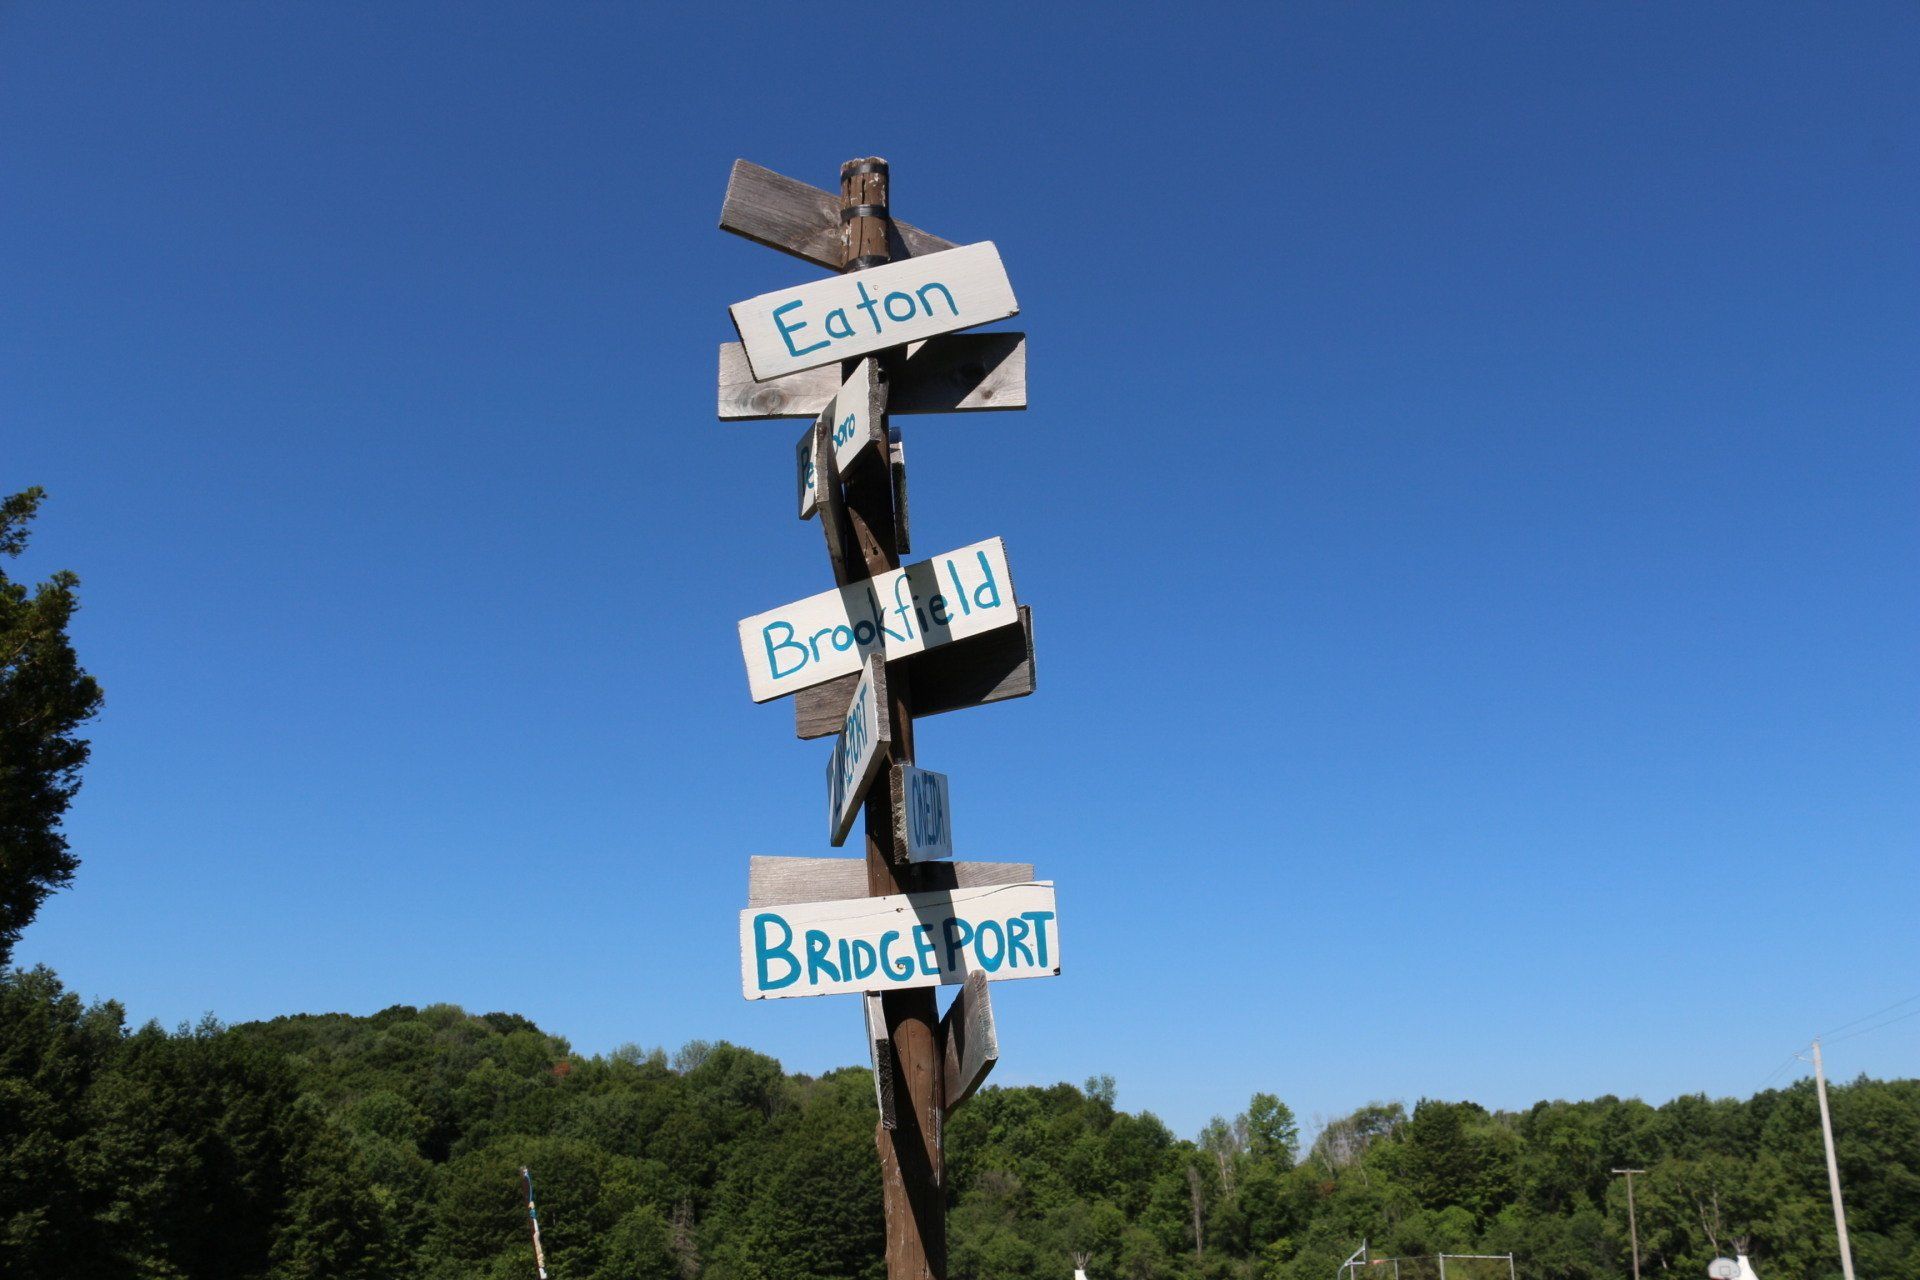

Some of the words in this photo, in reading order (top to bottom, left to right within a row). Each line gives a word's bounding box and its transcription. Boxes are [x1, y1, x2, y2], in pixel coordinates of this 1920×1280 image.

[773, 280, 959, 357] Eaton
[762, 550, 1001, 680] Brookfield
[912, 772, 946, 848] ONEIDA
[753, 911, 1055, 991] BRIDGEPORT
